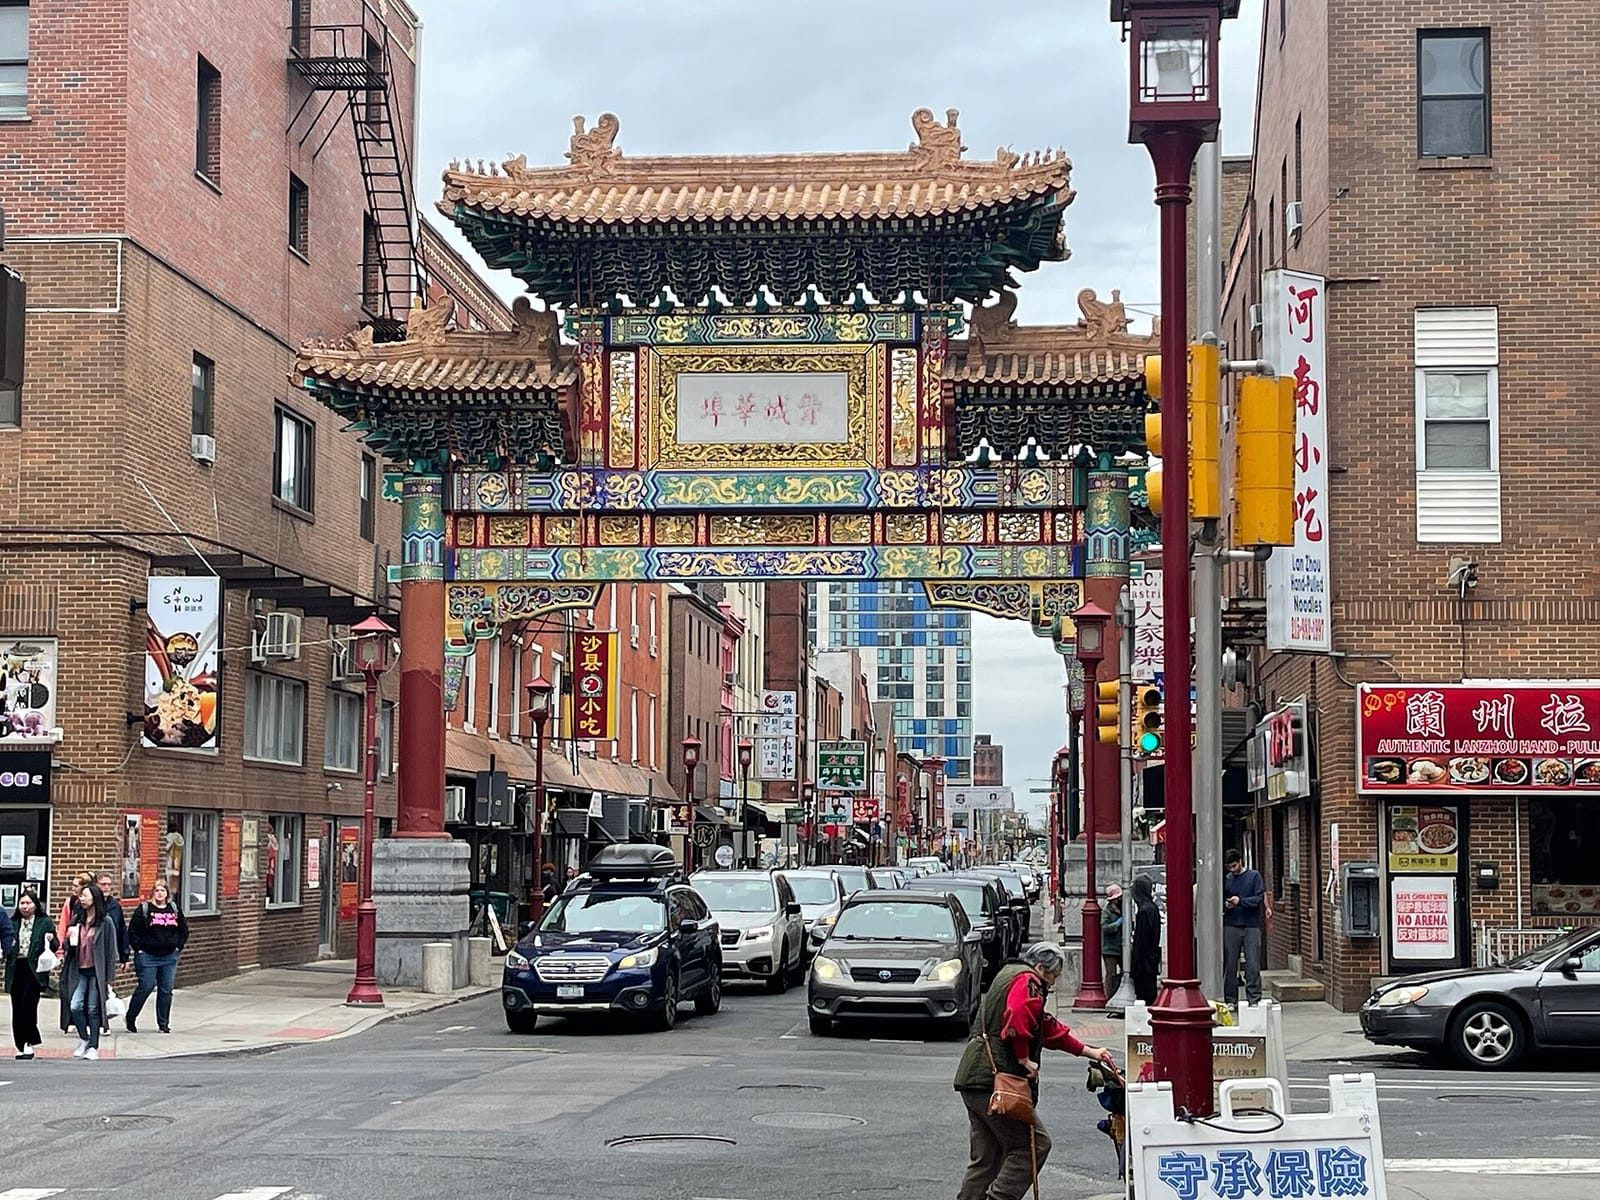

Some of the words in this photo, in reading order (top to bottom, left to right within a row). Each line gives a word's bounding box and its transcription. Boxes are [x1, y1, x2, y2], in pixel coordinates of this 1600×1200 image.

[1292, 594, 1322, 613] Noodles
[580, 635, 603, 735] 沙县小吃
[1406, 690, 1591, 739] 蘭州拉
[1377, 739, 1451, 754] AUTHENTIC
[1454, 739, 1518, 754] LANZHOU
[1397, 914, 1412, 926] NO
[1414, 914, 1448, 926] ARENA
[1219, 1043, 1257, 1059] Philly
[1158, 1145, 1370, 1200] 守承保險
